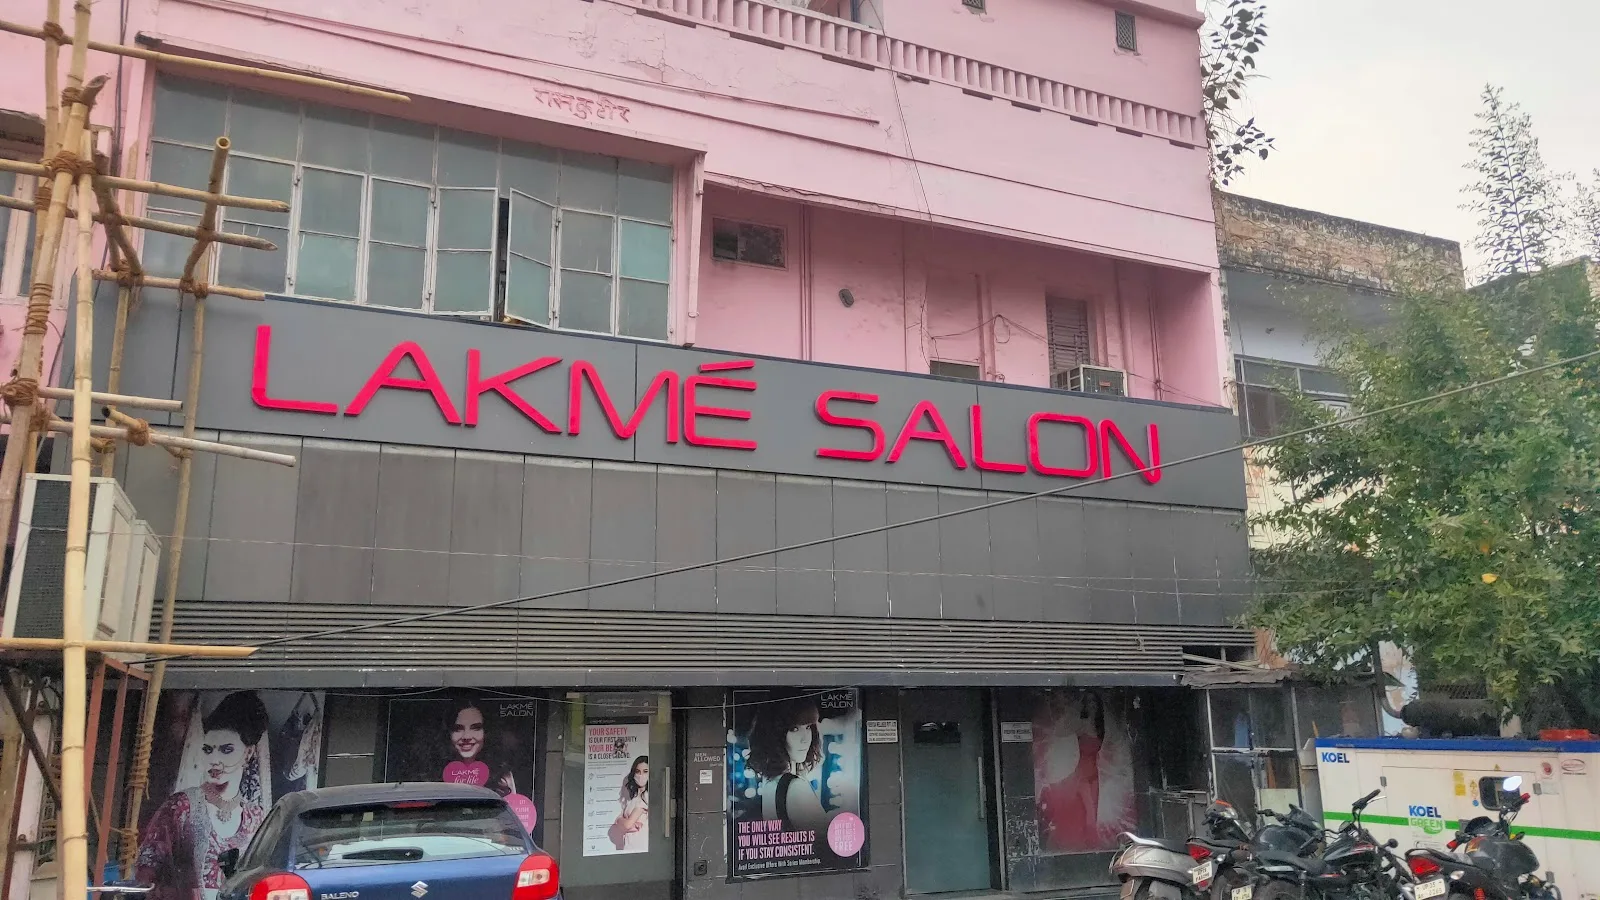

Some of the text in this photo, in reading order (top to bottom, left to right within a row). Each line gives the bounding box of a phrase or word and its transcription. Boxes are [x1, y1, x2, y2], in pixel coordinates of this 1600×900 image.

[251, 324, 1163, 484] LAKMÉ SALON
[820, 691, 853, 701] LAKMÉ
[500, 702, 533, 710] LAKMÉ
[820, 701, 853, 709] SALON
[589, 727, 628, 736] YOUR SAFETY
[588, 744, 604, 752] YOUR
[1321, 752, 1350, 763] KOEL
[451, 768, 480, 776] LAKMÉ
[1409, 805, 1442, 818] KOEL
[738, 819, 782, 833] THE ONLY WAY
[1410, 818, 1443, 830] GREEN
[738, 830, 815, 847] YOU WILL SEE RESULTS IS
[738, 843, 815, 860] IF YOU STAY CONSISTENT.
[320, 891, 360, 900] BALENO
